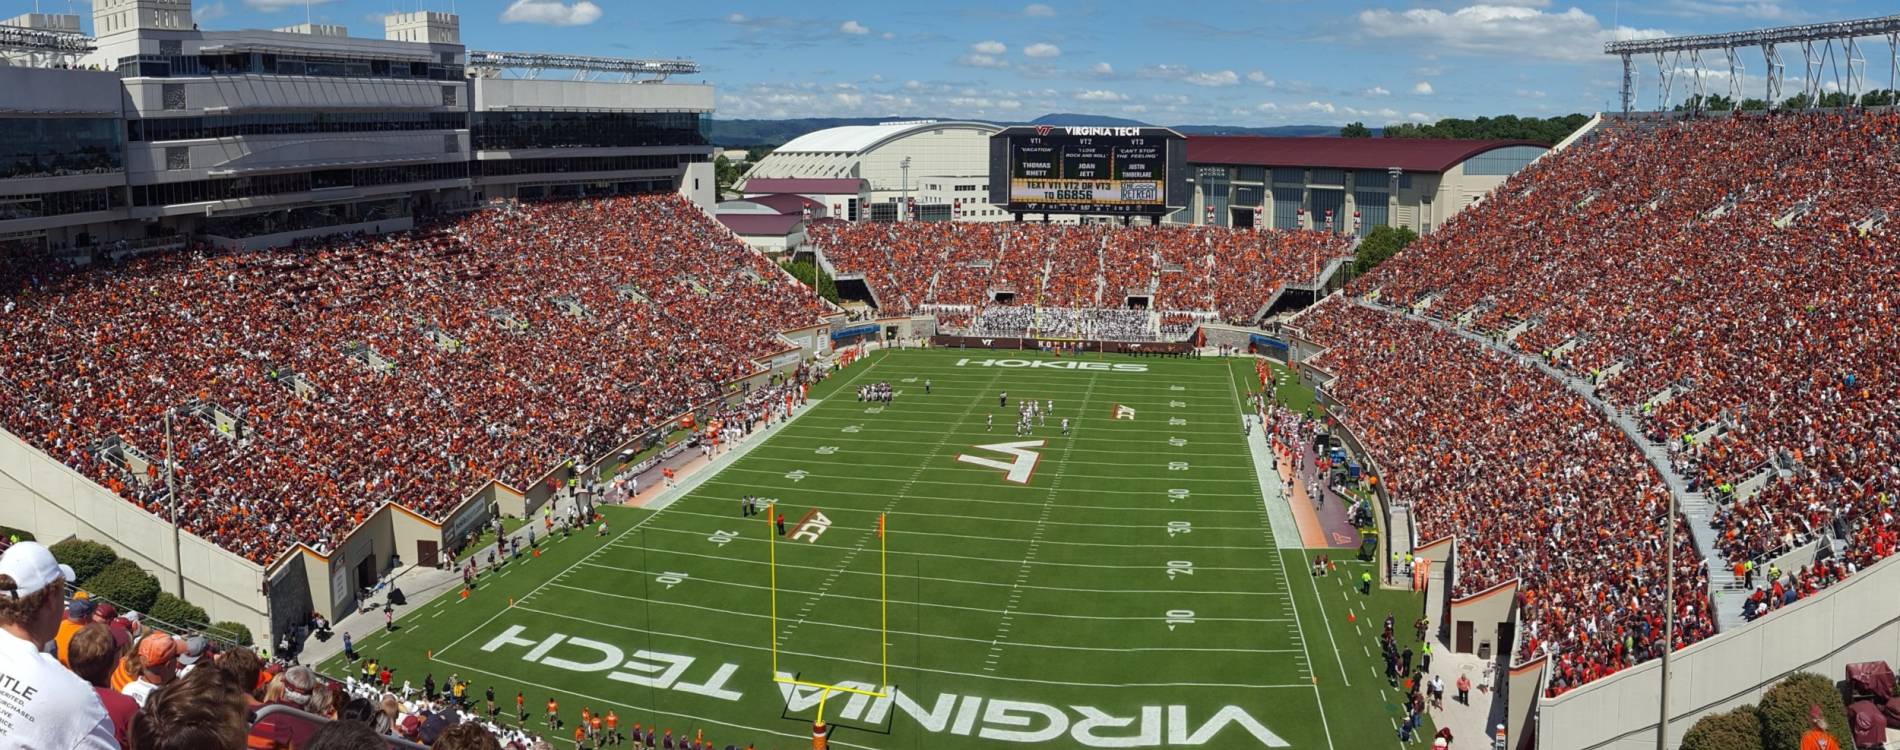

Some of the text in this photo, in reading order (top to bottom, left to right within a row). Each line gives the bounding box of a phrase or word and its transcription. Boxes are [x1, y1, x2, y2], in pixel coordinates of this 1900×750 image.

[1065, 126, 1140, 136] VIRGINIA TECH
[1027, 181, 1046, 189] TEXT
[1063, 182, 1080, 190] VT2
[1081, 182, 1093, 190] OR
[1095, 182, 1111, 190] VT3
[1044, 190, 1093, 200] TO 66856
[1121, 189, 1156, 200] RETREAT
[956, 358, 1149, 372] HOKIES
[957, 439, 1046, 485] VT
[1167, 488, 1190, 499] 40
[792, 511, 832, 543] ACC
[1167, 521, 1192, 534] 30
[707, 529, 739, 543] 20
[1166, 560, 1194, 575] 20
[655, 571, 688, 585] 10
[1165, 609, 1195, 624] 10
[479, 624, 1291, 748] VIRGINIA TECH
